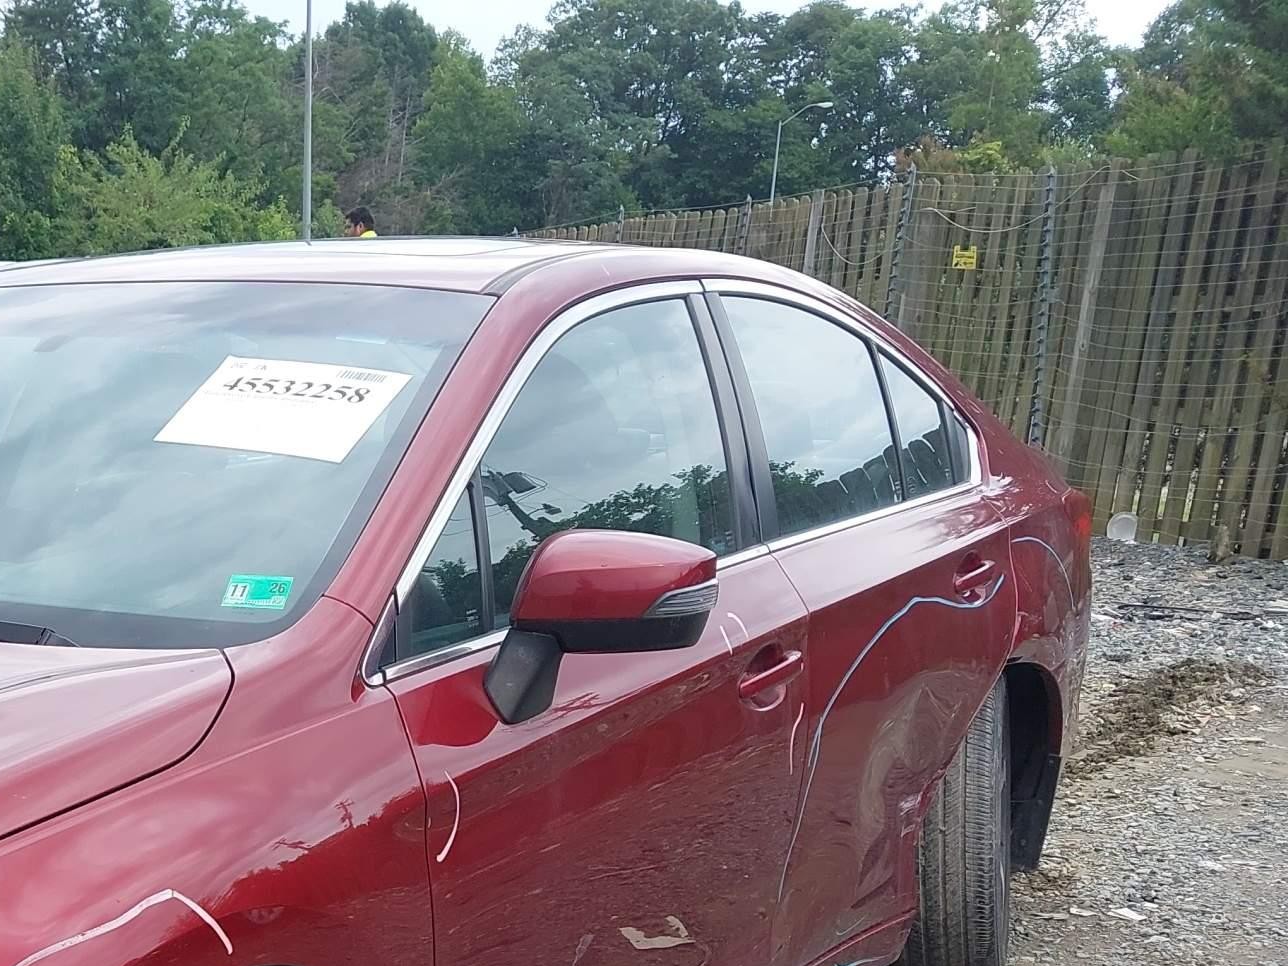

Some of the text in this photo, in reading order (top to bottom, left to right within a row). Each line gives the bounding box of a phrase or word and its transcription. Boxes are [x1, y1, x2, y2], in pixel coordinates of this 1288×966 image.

[224, 376, 371, 404] 45532258
[230, 582, 288, 598] 11 26
